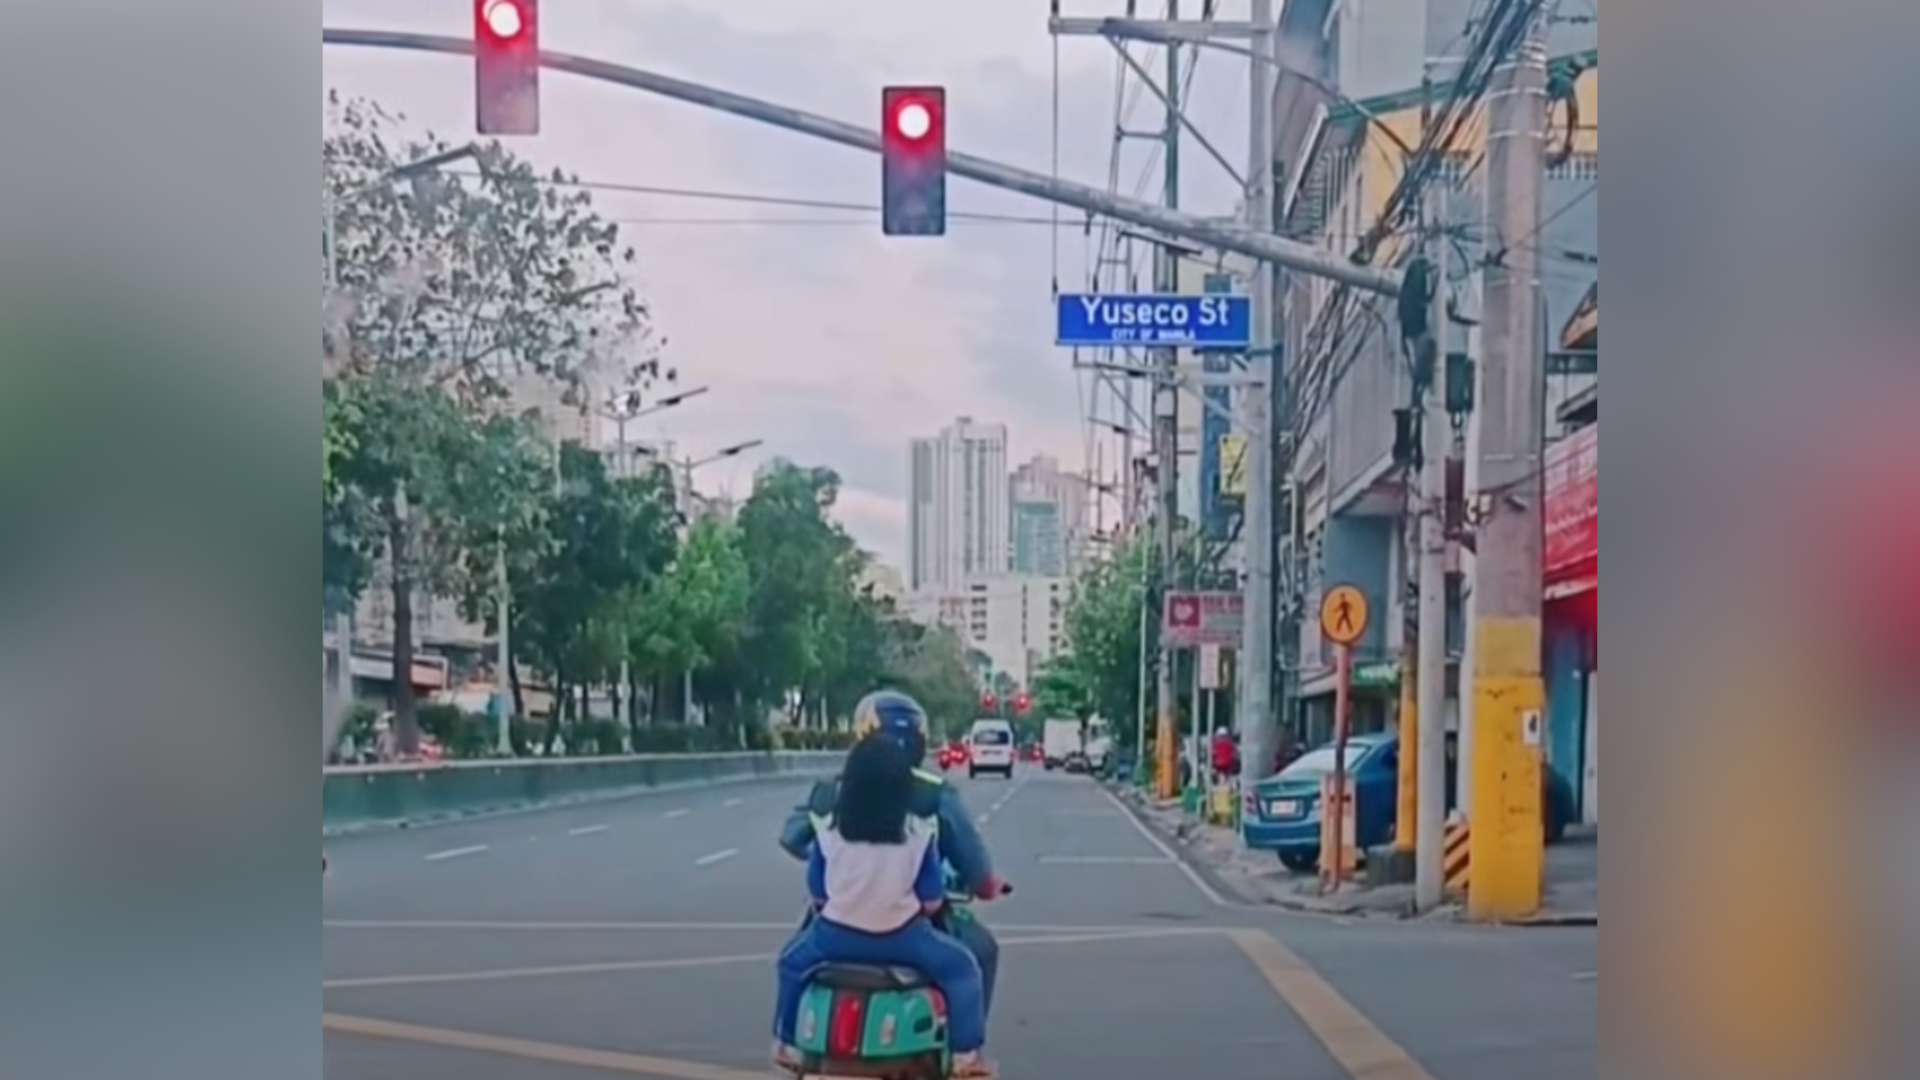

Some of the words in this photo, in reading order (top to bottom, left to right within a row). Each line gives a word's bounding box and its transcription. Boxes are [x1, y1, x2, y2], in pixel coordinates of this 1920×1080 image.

[1081, 296, 1189, 326] Yuseco
[1198, 297, 1229, 326] St
[1112, 328, 1136, 340] CITY
[1140, 328, 1154, 340] OF
